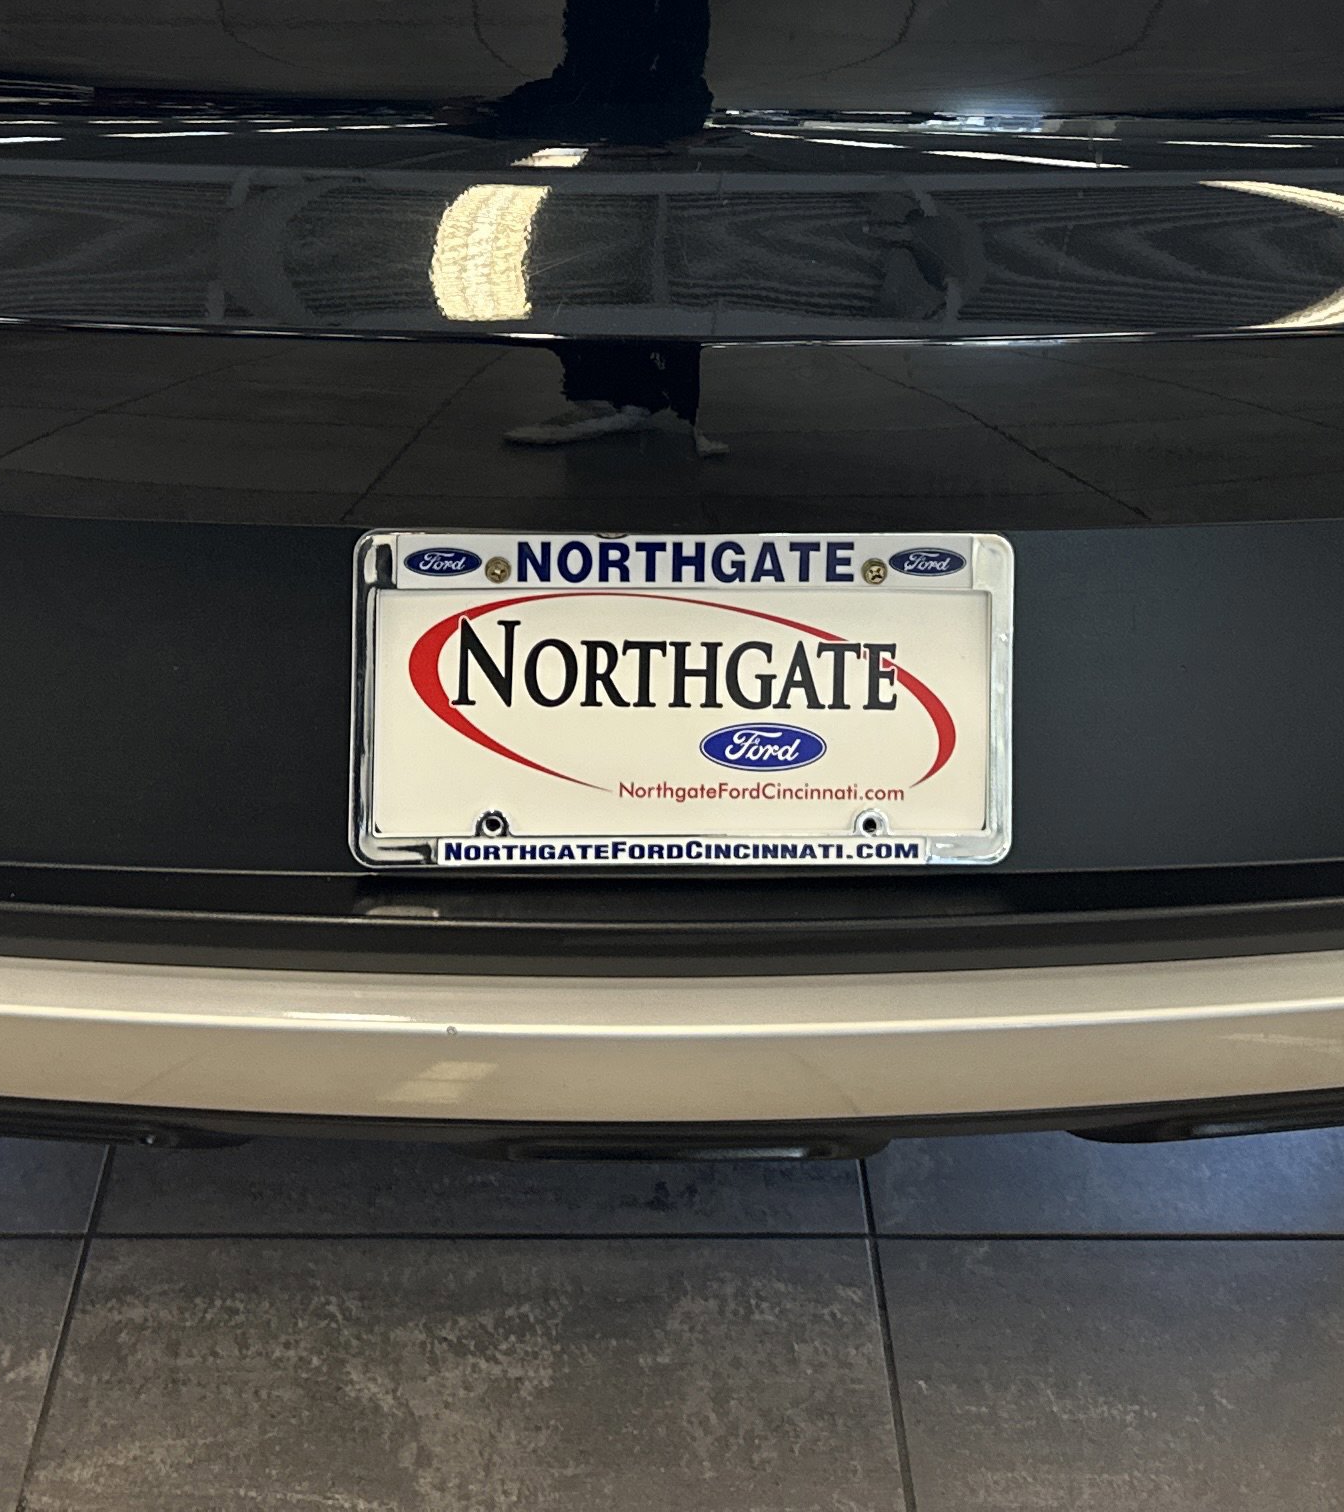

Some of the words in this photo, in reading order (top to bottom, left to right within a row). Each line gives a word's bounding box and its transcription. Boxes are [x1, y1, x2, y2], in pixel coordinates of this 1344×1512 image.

[419, 551, 467, 571] Ford
[516, 541, 855, 583] NORTHGATE
[903, 551, 951, 571] Ford
[451, 618, 898, 711] NORTHGATE
[724, 729, 801, 761] Ford
[619, 781, 905, 803] NorthgateFordCincinnati.com
